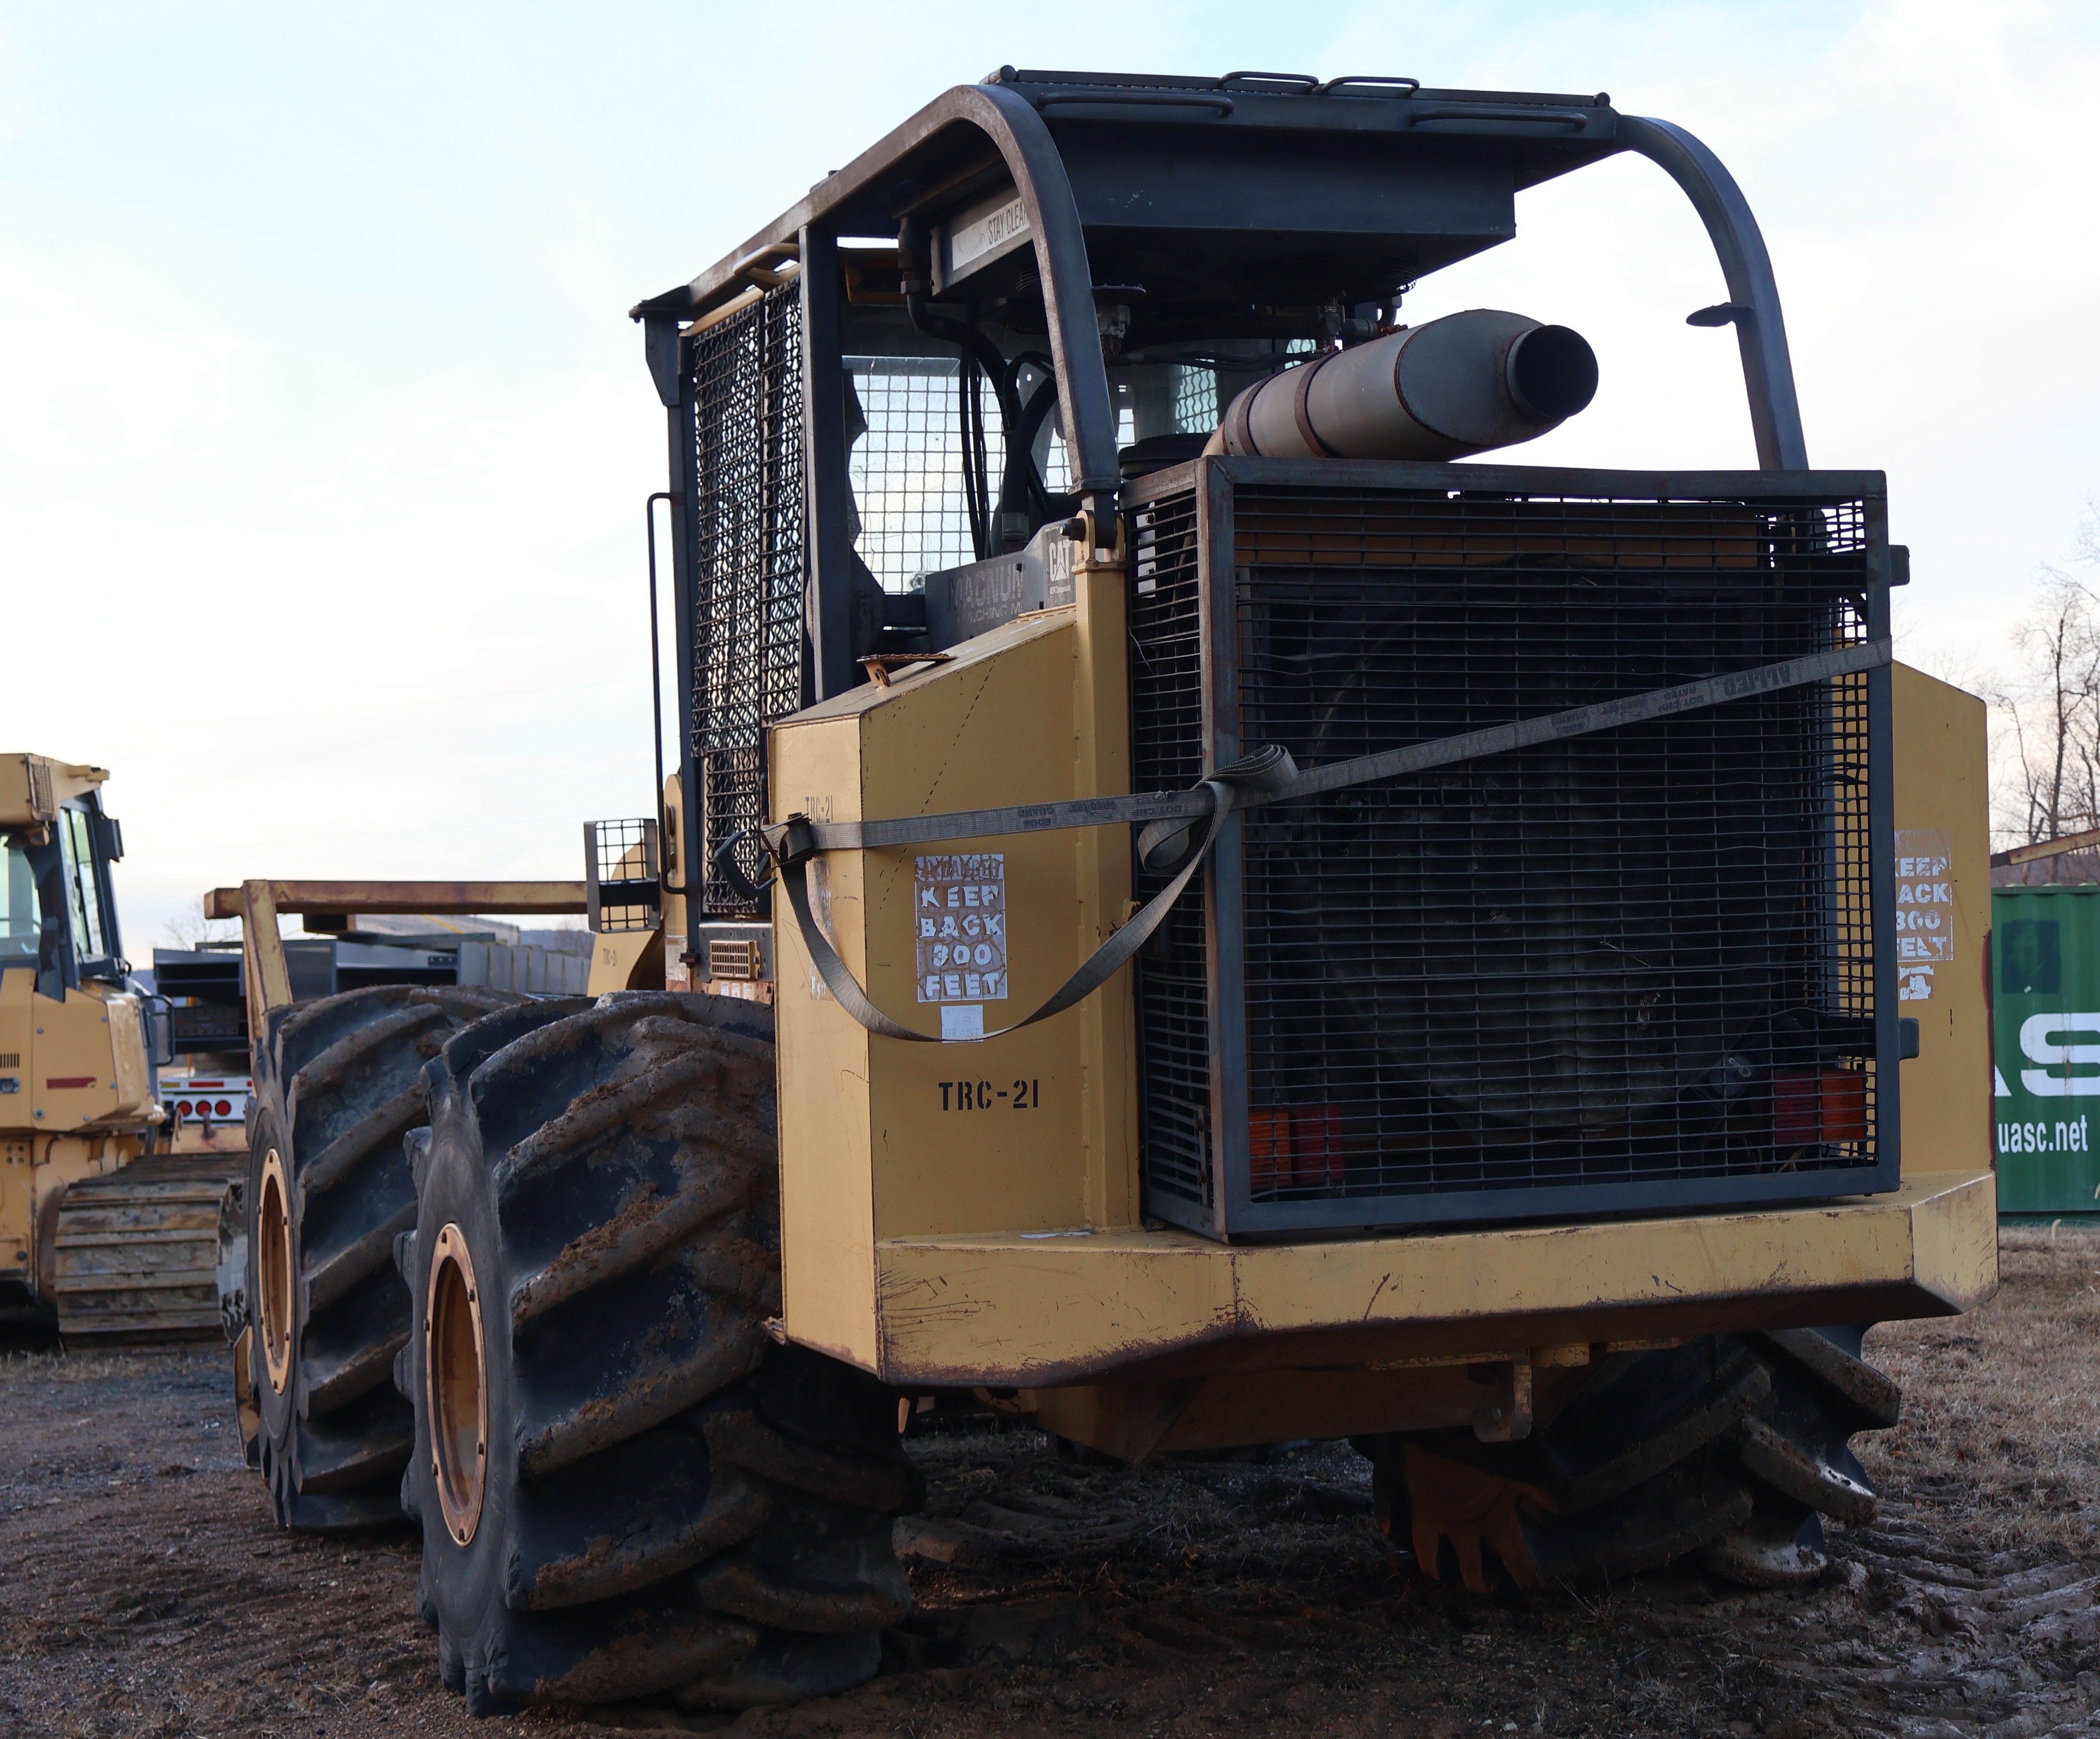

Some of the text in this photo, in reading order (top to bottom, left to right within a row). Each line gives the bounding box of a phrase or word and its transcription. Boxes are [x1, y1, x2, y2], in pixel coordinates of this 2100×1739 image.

[989, 213, 1003, 245] STAY
[1049, 539, 1070, 582] CAT
[948, 563, 1023, 612] MAGNUM
[1723, 664, 1790, 696] ALLIED
[806, 795, 833, 824] TRC-21
[1895, 857, 1947, 877] EEP
[921, 885, 998, 907] KEEP
[1897, 883, 1949, 903] ACK
[919, 914, 1003, 937] BACK
[1896, 910, 1940, 930] 300
[933, 944, 992, 966] 300
[1897, 936, 1946, 956] EET
[926, 973, 999, 996] FEET
[953, 1016, 971, 1026] AIR
[943, 1028, 980, 1038] BLAST
[939, 1079, 1038, 1110] TRC-21
[1998, 1114, 2088, 1153] uasc.net
